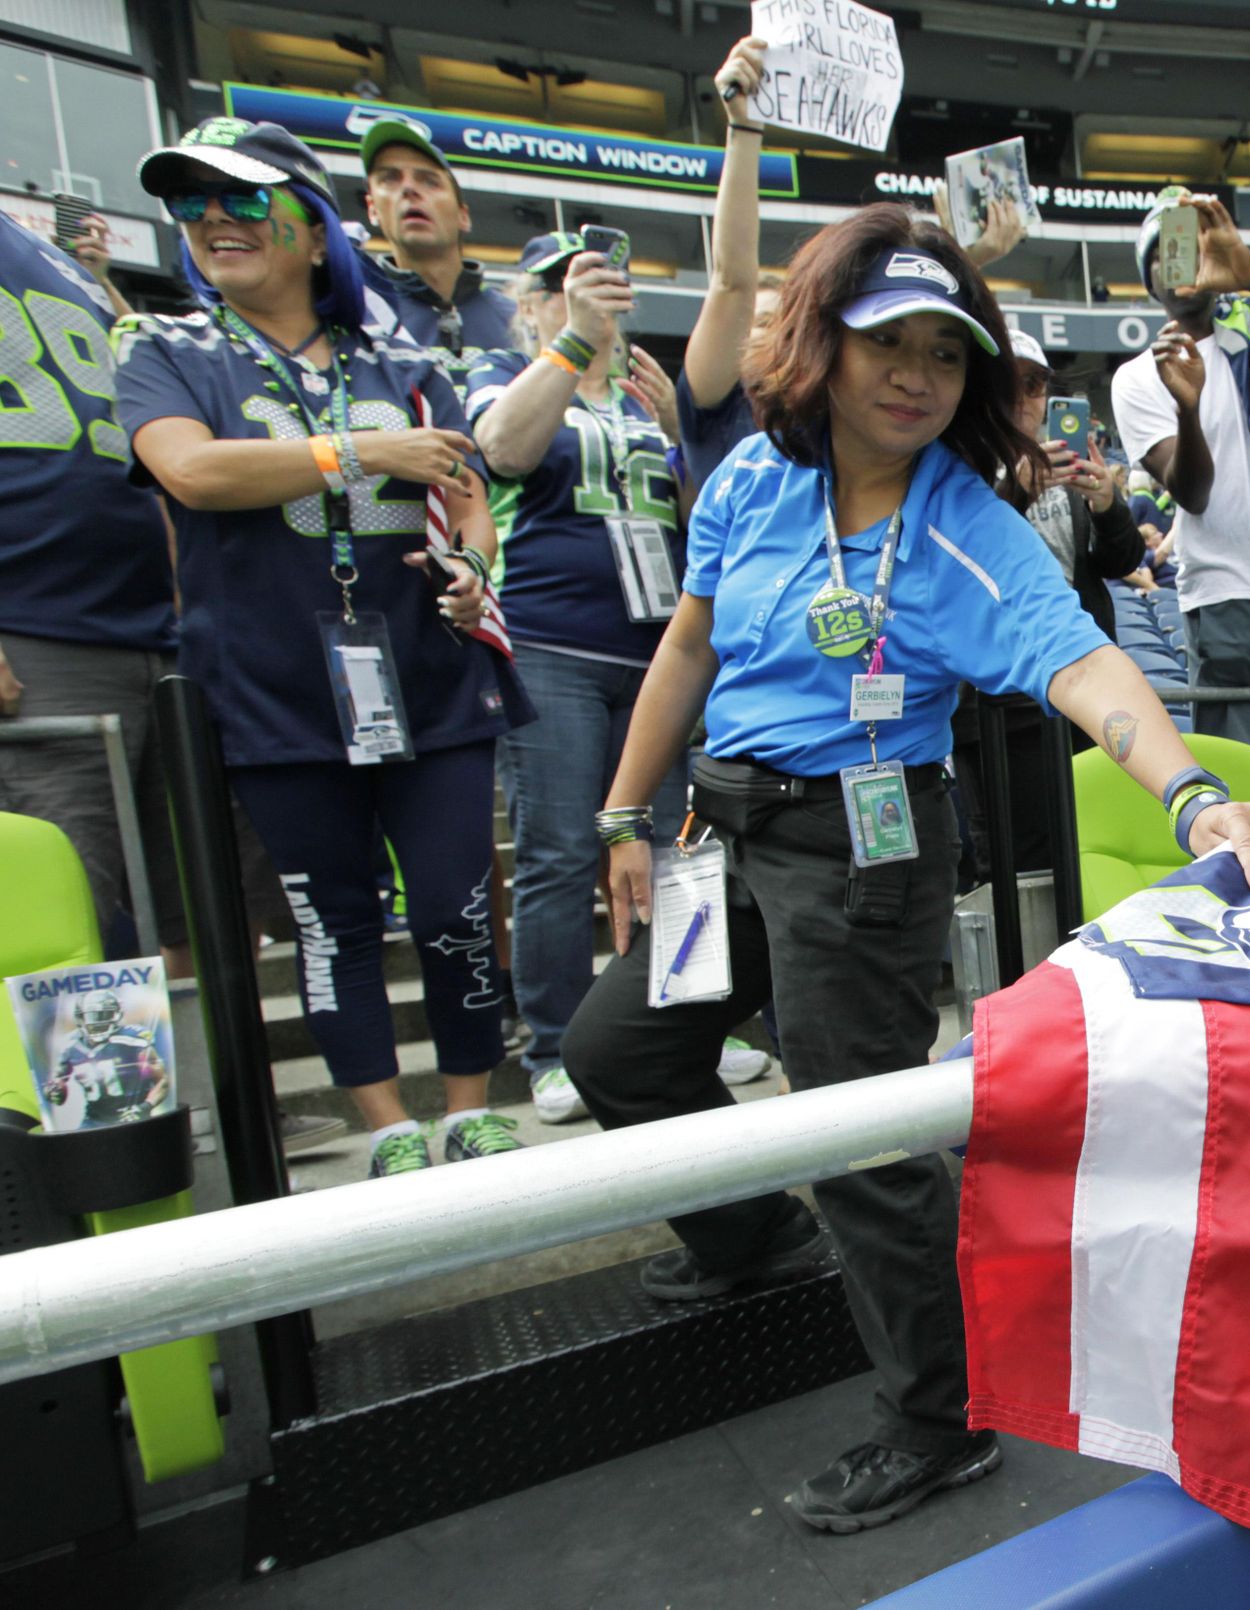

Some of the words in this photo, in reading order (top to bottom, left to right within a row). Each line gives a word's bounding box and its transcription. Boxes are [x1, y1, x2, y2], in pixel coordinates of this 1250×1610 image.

[823, 0, 894, 44] FLORIDA
[837, 35, 898, 79] LOVES
[753, 68, 887, 147] SEAHAWKS
[462, 127, 588, 163] CAPTION
[596, 145, 708, 178] WINDOW
[809, 601, 841, 617] Thank
[812, 610, 864, 640] 12s
[855, 690, 901, 701] GERBIELYN
[279, 873, 339, 1014] LADYHAWK
[22, 965, 153, 1002] GAMEDAY
